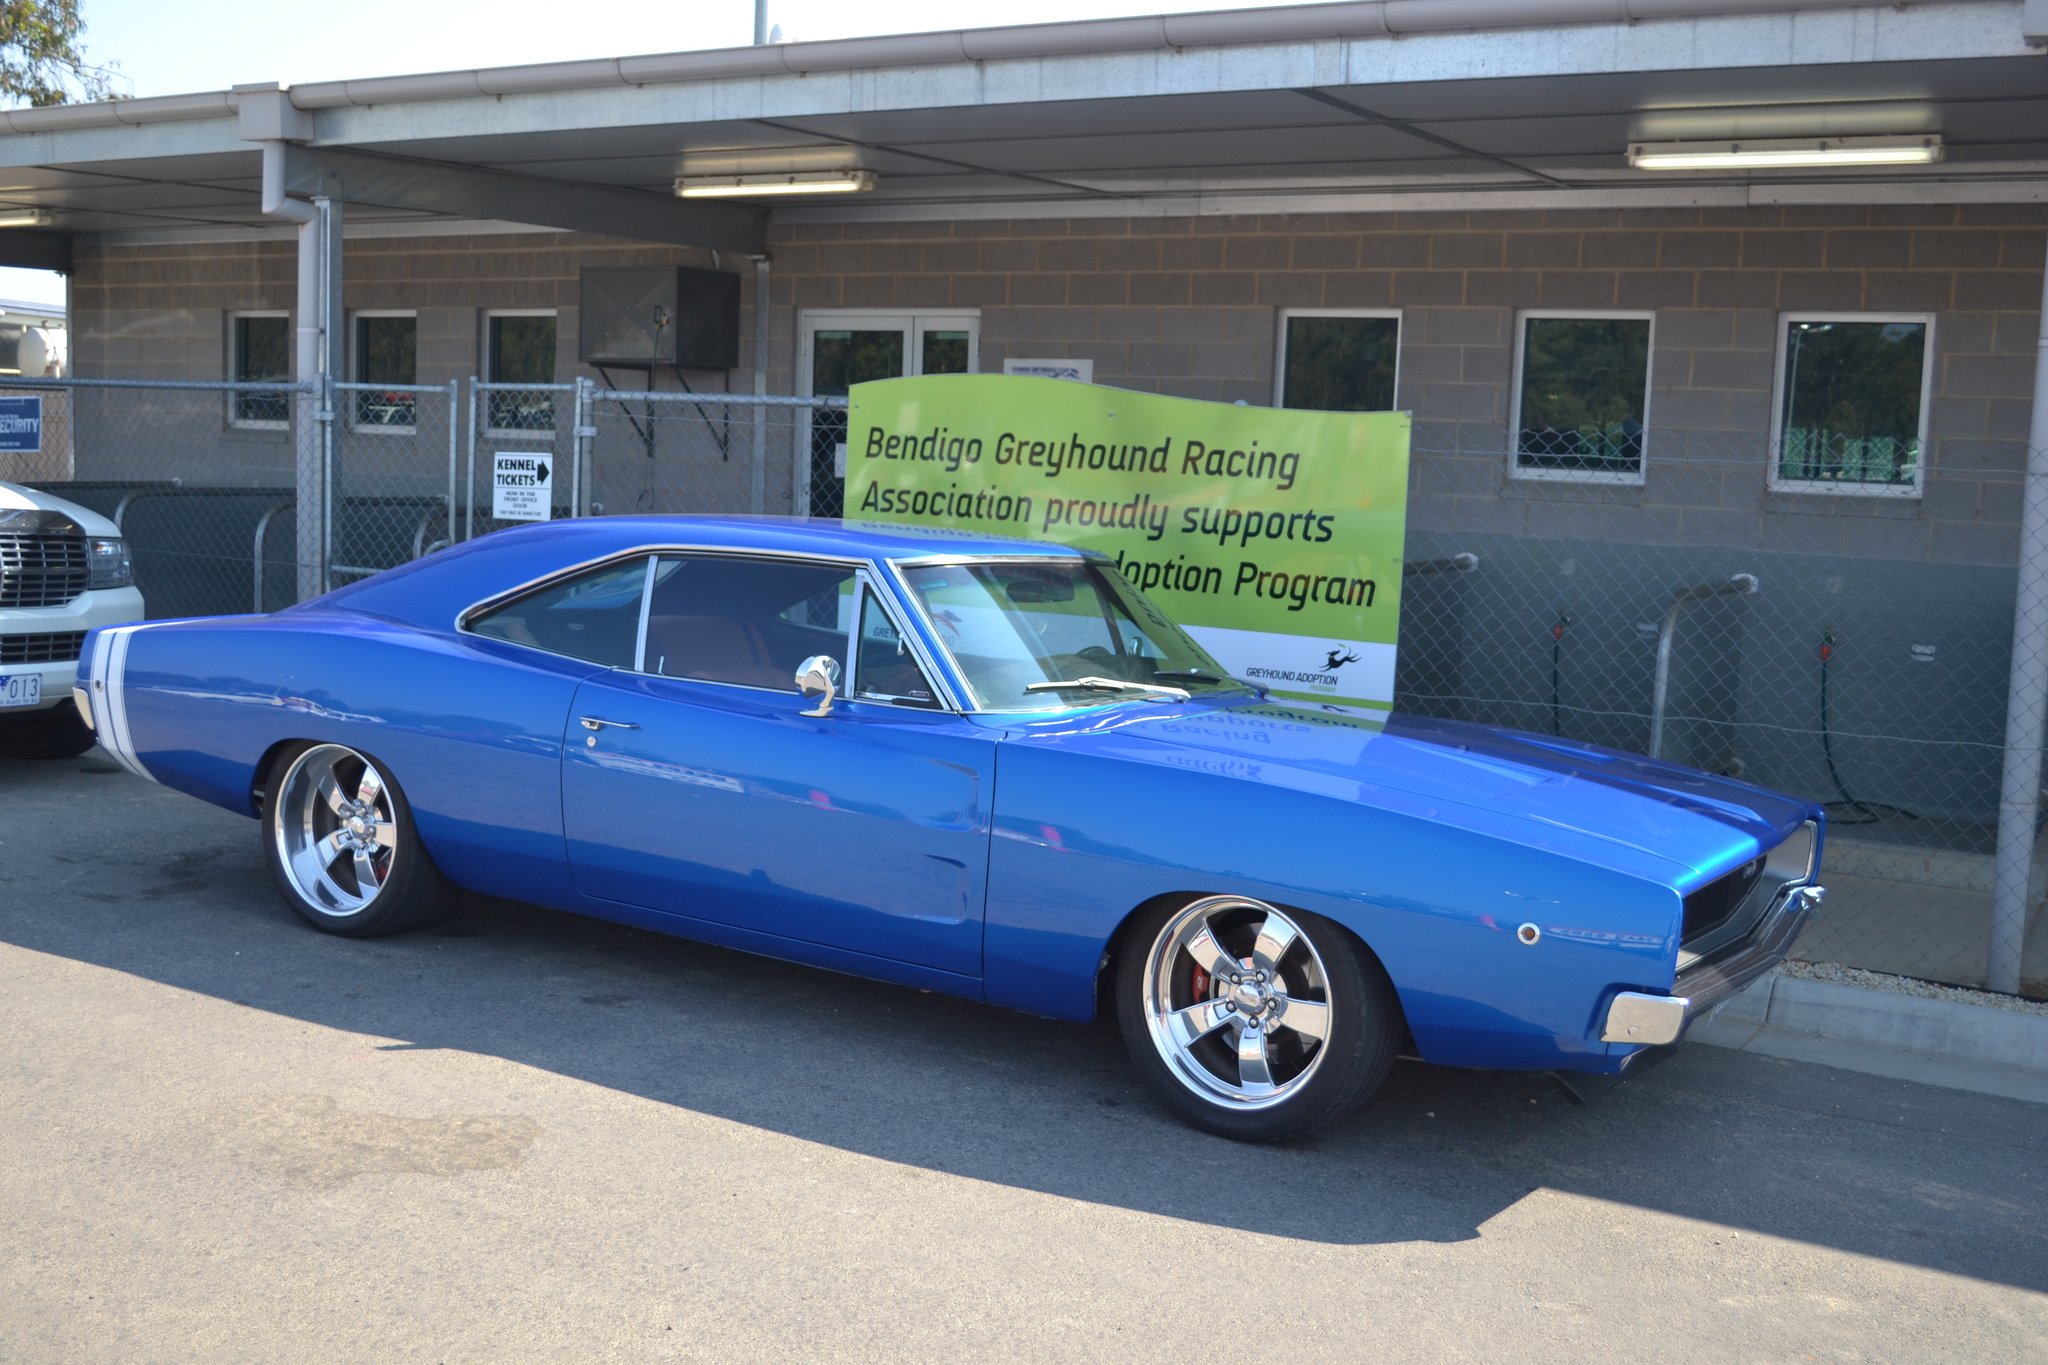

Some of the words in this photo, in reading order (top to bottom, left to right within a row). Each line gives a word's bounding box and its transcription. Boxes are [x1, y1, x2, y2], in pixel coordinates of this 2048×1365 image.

[0, 418, 39, 433] ECURITY
[497, 459, 536, 471] KENNEL
[865, 426, 983, 472] Bendigo
[995, 432, 1171, 477] Greyhound
[1181, 440, 1299, 490] Racing
[497, 474, 535, 486] TICKETS
[860, 480, 1032, 523] Association
[1042, 494, 1169, 541] proudly
[1181, 505, 1334, 547] supports
[1116, 550, 1222, 593] option
[1233, 561, 1376, 611] Program
[1245, 667, 1295, 681] GREYHOUND
[1296, 672, 1338, 685] ADOPTION
[10, 678, 38, 698] 013
[1309, 684, 1336, 692] PROGRAM
